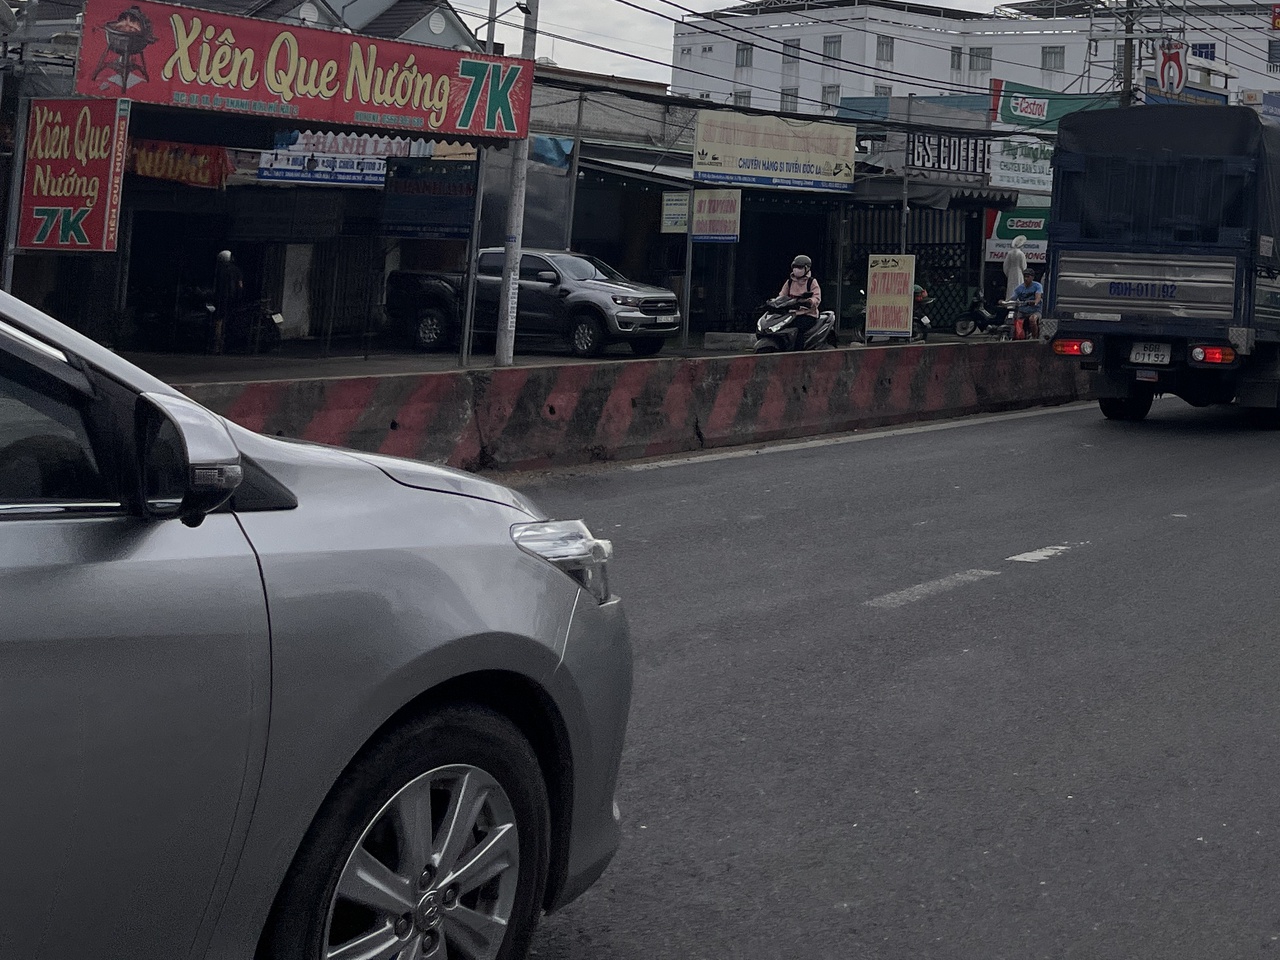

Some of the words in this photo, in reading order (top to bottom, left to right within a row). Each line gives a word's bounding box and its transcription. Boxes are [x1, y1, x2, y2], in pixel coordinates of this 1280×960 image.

[162, 13, 259, 91] Xiên
[264, 31, 340, 103] Que
[344, 41, 450, 130] Nướng
[456, 58, 523, 134] 7K
[1019, 97, 1046, 118] Castrol
[29, 106, 70, 160] Xiên
[74, 106, 111, 167] Que
[33, 164, 99, 208] Nướng
[33, 207, 91, 246] 7K
